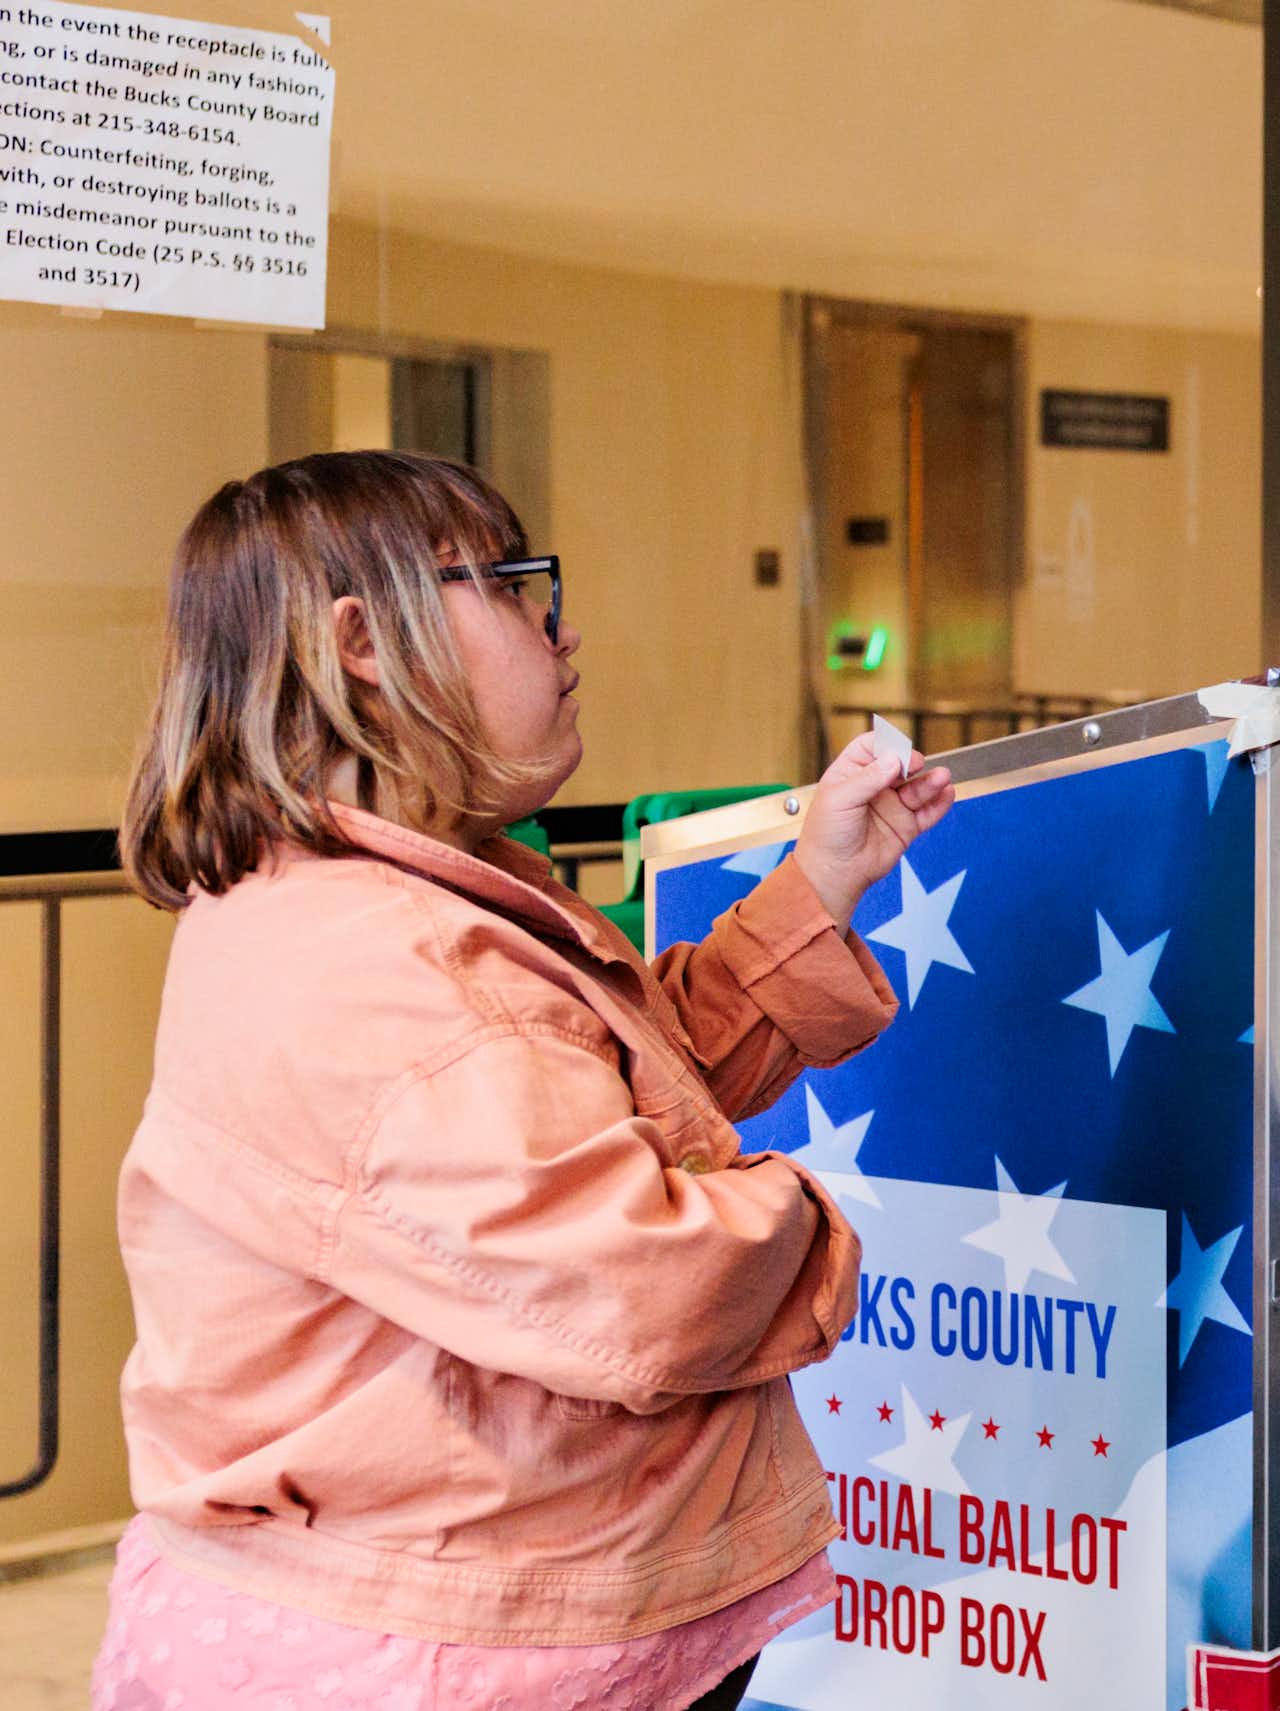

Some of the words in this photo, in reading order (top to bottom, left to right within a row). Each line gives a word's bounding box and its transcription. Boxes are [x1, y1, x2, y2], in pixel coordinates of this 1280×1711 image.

[18, 9, 53, 28] the
[61, 18, 121, 37] event
[128, 21, 160, 44] the
[167, 34, 265, 60] receptacle
[272, 45, 286, 62] is
[34, 45, 56, 59] or
[63, 45, 79, 62] is
[85, 52, 178, 77] damaged
[184, 67, 200, 80] in
[207, 71, 242, 89] any
[249, 76, 325, 100] fashion,
[0, 102, 65, 124] ctions
[72, 112, 90, 127] at
[98, 113, 241, 147] 215-348-6154.
[1, 72, 79, 94] contact
[86, 81, 118, 100] the
[125, 86, 180, 108] Bucks
[187, 95, 257, 121] County
[263, 106, 320, 127] Board
[40, 139, 194, 176] Counterfeiting,
[201, 159, 275, 186] forging,
[53, 174, 75, 189] or
[82, 176, 188, 207] destroying
[196, 189, 260, 212] ballots
[267, 200, 280, 215] is
[287, 205, 297, 217] a
[16, 199, 158, 230] misdemeanor
[165, 219, 251, 242] pursuant
[259, 228, 279, 244] to
[285, 231, 316, 249] the
[6, 229, 89, 253] Election
[96, 239, 146, 260] Code
[153, 243, 184, 264] (25
[191, 251, 225, 269] P.S.
[262, 258, 307, 277] 3516
[38, 264, 76, 282] and
[83, 269, 141, 292] 3517)
[841, 1272, 916, 1351] KS
[931, 1281, 1117, 1379] COUNTY
[826, 1471, 945, 1559] ICIAL
[959, 1494, 1128, 1590] BALLOT
[834, 1573, 945, 1660] DROP
[960, 1597, 1048, 1682] BOX
